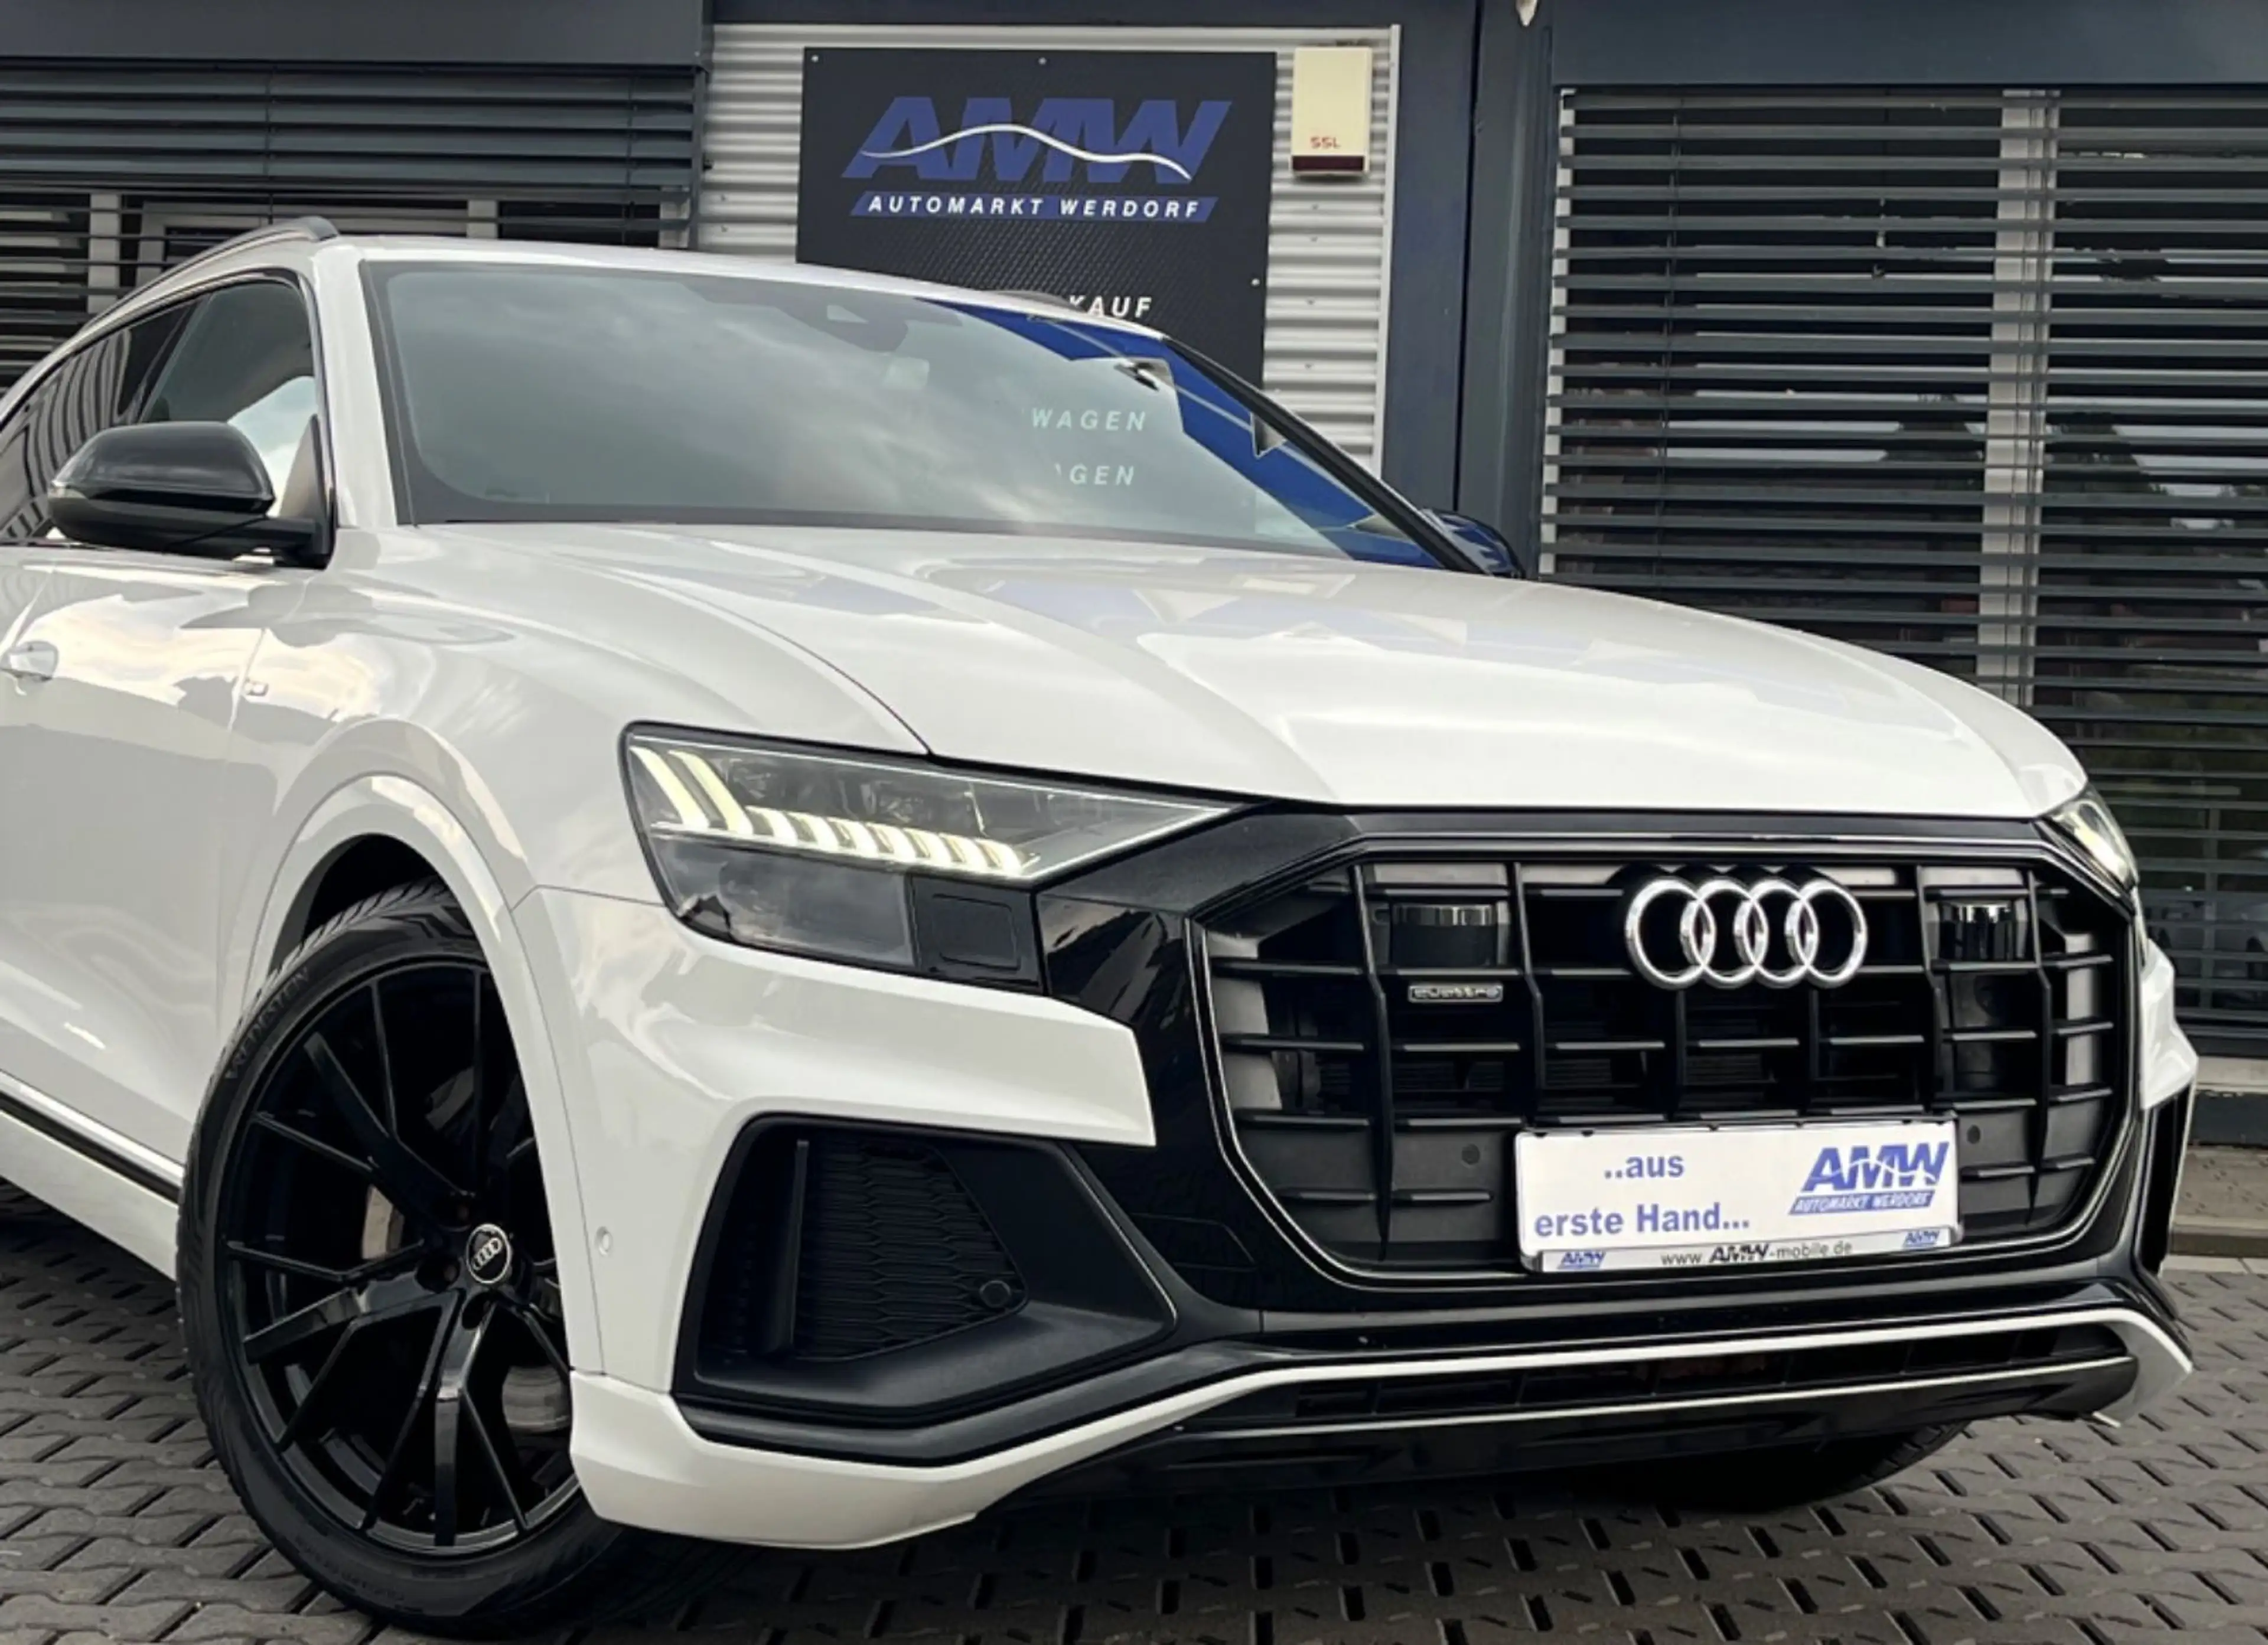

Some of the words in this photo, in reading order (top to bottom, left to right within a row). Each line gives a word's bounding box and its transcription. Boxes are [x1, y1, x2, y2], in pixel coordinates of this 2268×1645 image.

[841, 97, 1233, 184] AMW
[1311, 136, 1341, 149] SSL
[868, 195, 1044, 215] AUTOMARKT
[1060, 200, 1200, 218] WERDORF
[1800, 1141, 1949, 1192] AMW
[1534, 1206, 1624, 1238] erste
